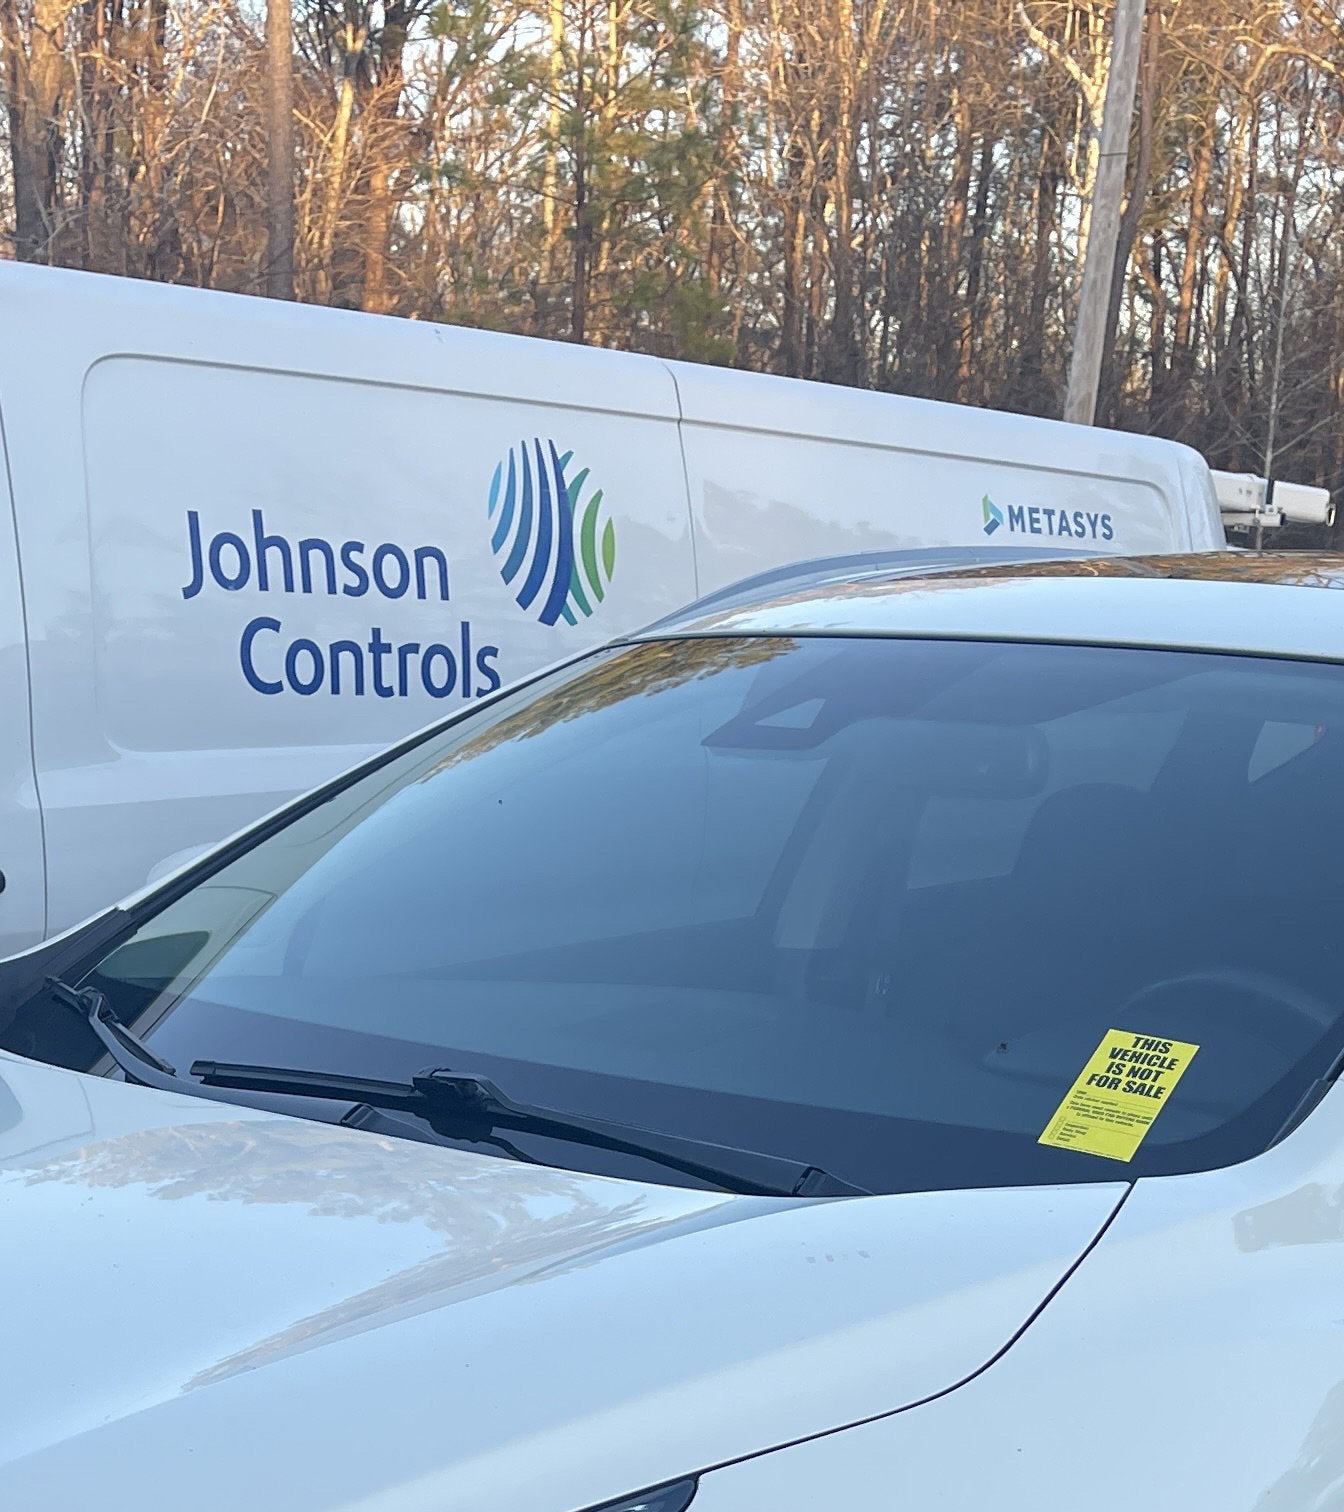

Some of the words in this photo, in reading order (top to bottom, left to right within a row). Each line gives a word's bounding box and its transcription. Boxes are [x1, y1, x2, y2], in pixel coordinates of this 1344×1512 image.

[1007, 504, 1114, 541] METASYS
[181, 508, 450, 602] Johnson
[239, 616, 501, 699] Controls
[1131, 1036, 1173, 1054] THIS
[1109, 1047, 1179, 1071] VEHICLE
[1105, 1062, 1127, 1076] IS
[1126, 1065, 1164, 1083] NOT
[1086, 1074, 1122, 1091] FOR
[1122, 1080, 1166, 1100] SALE
